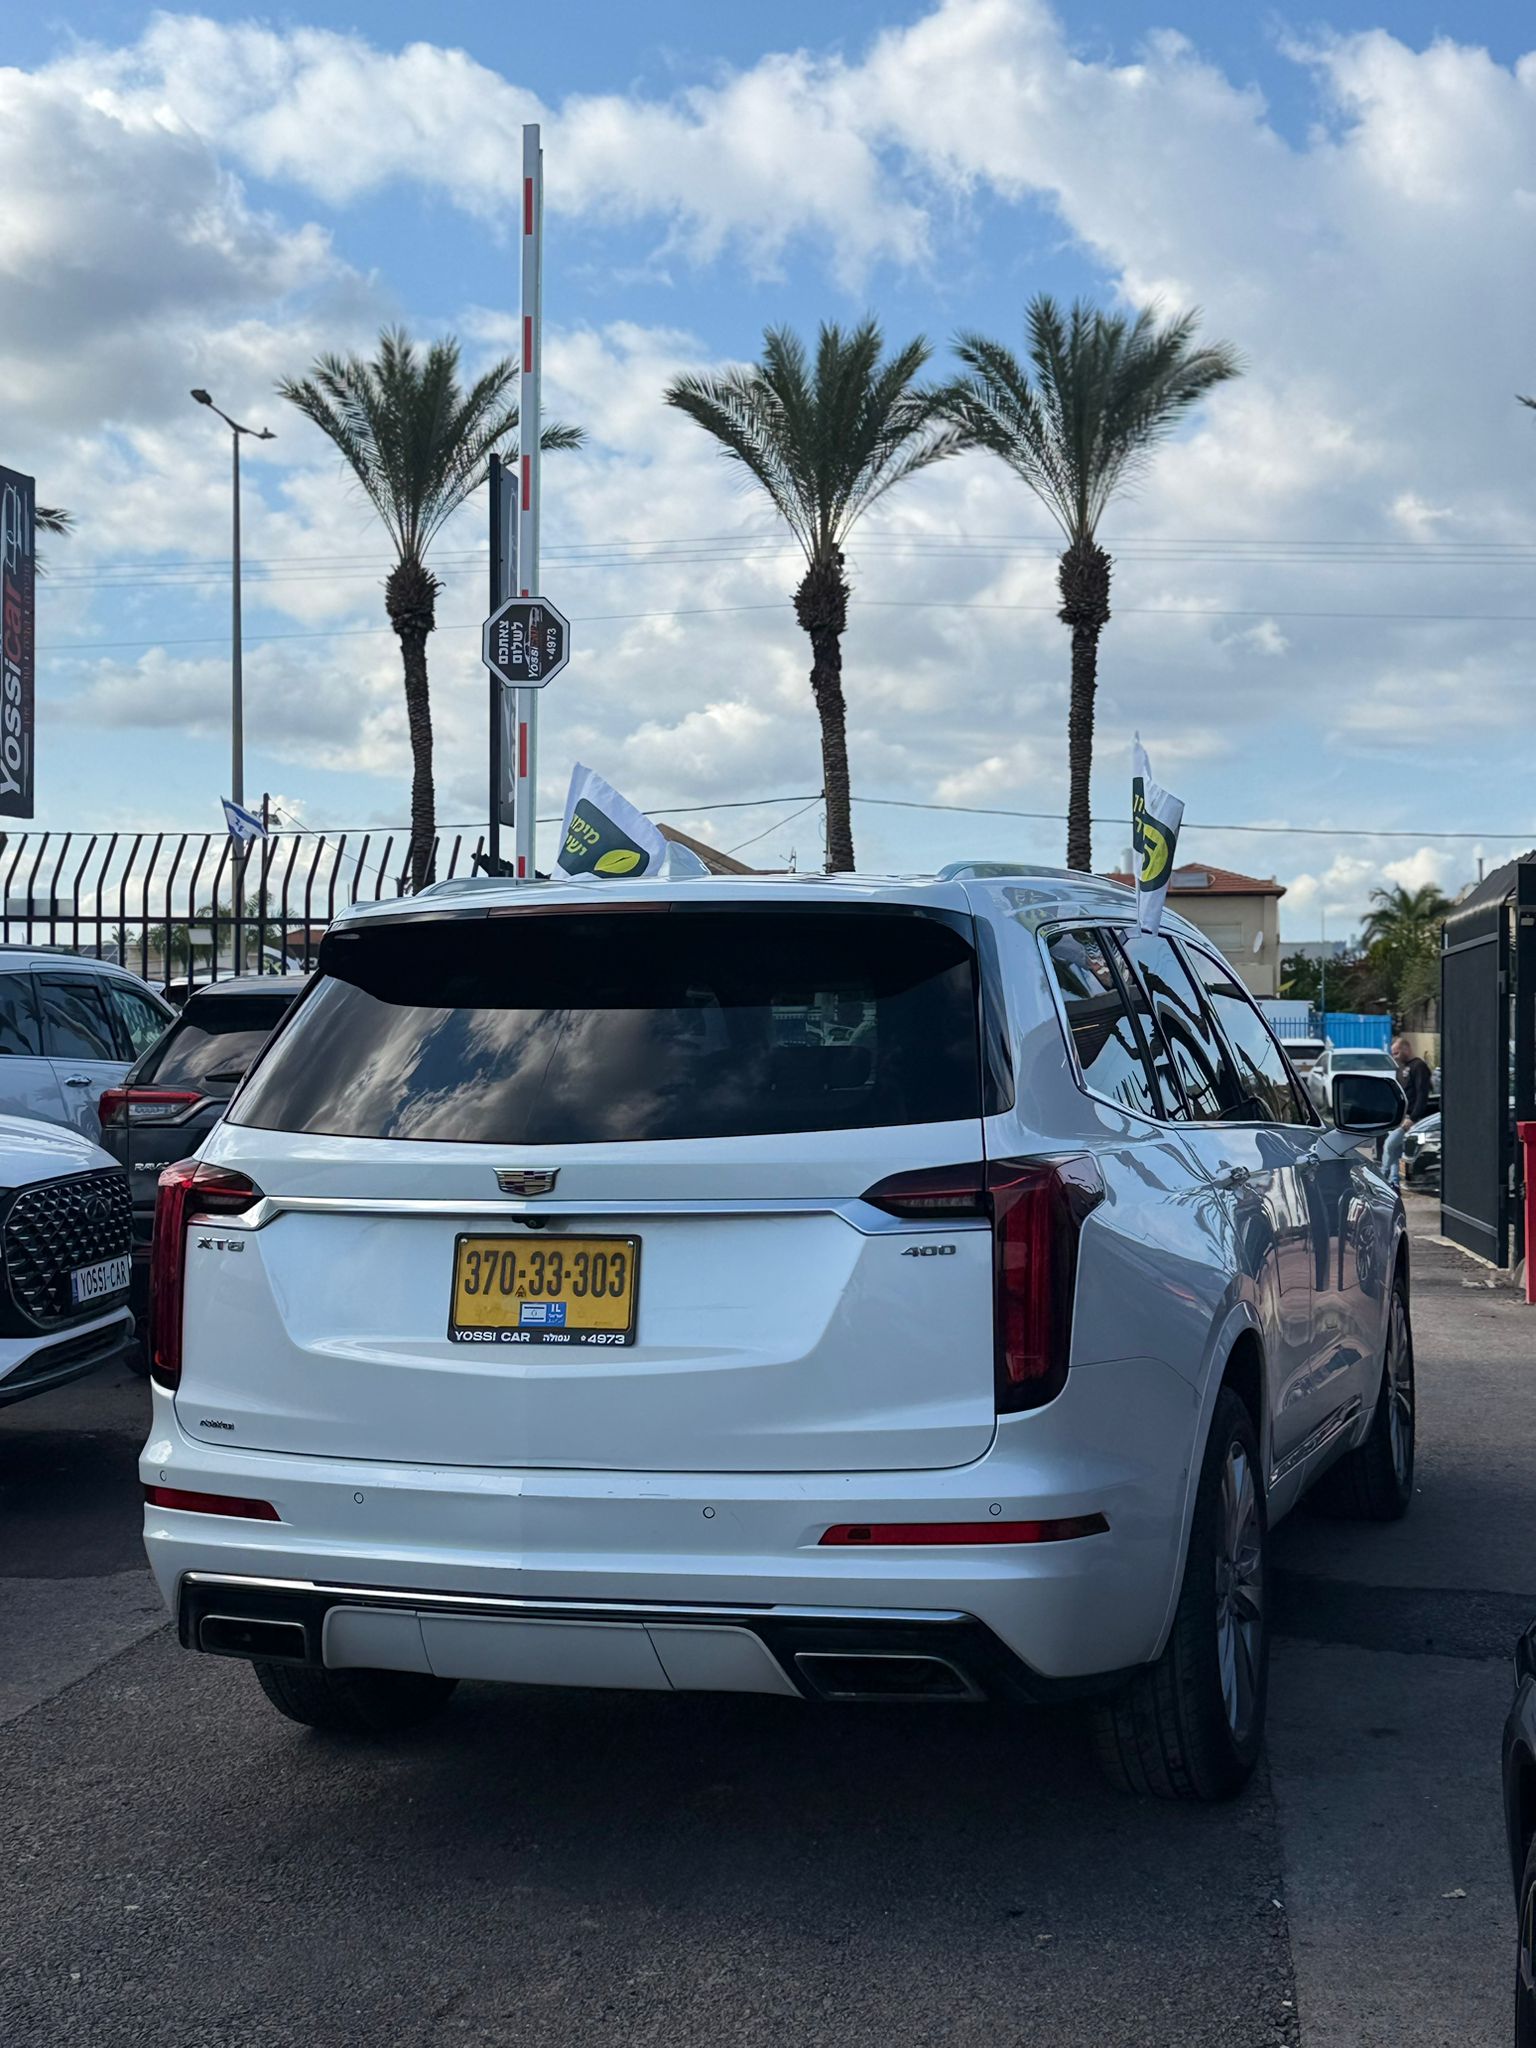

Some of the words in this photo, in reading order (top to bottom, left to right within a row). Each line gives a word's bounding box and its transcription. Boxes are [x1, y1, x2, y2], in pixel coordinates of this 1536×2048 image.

[499, 620, 509, 664] צאתכם
[511, 622, 523, 664] לשלום
[570, 814, 600, 844] מימו
[900, 1244, 957, 1257] 400
[455, 1331, 497, 1342] YOSSI
[501, 1331, 531, 1342] CAR
